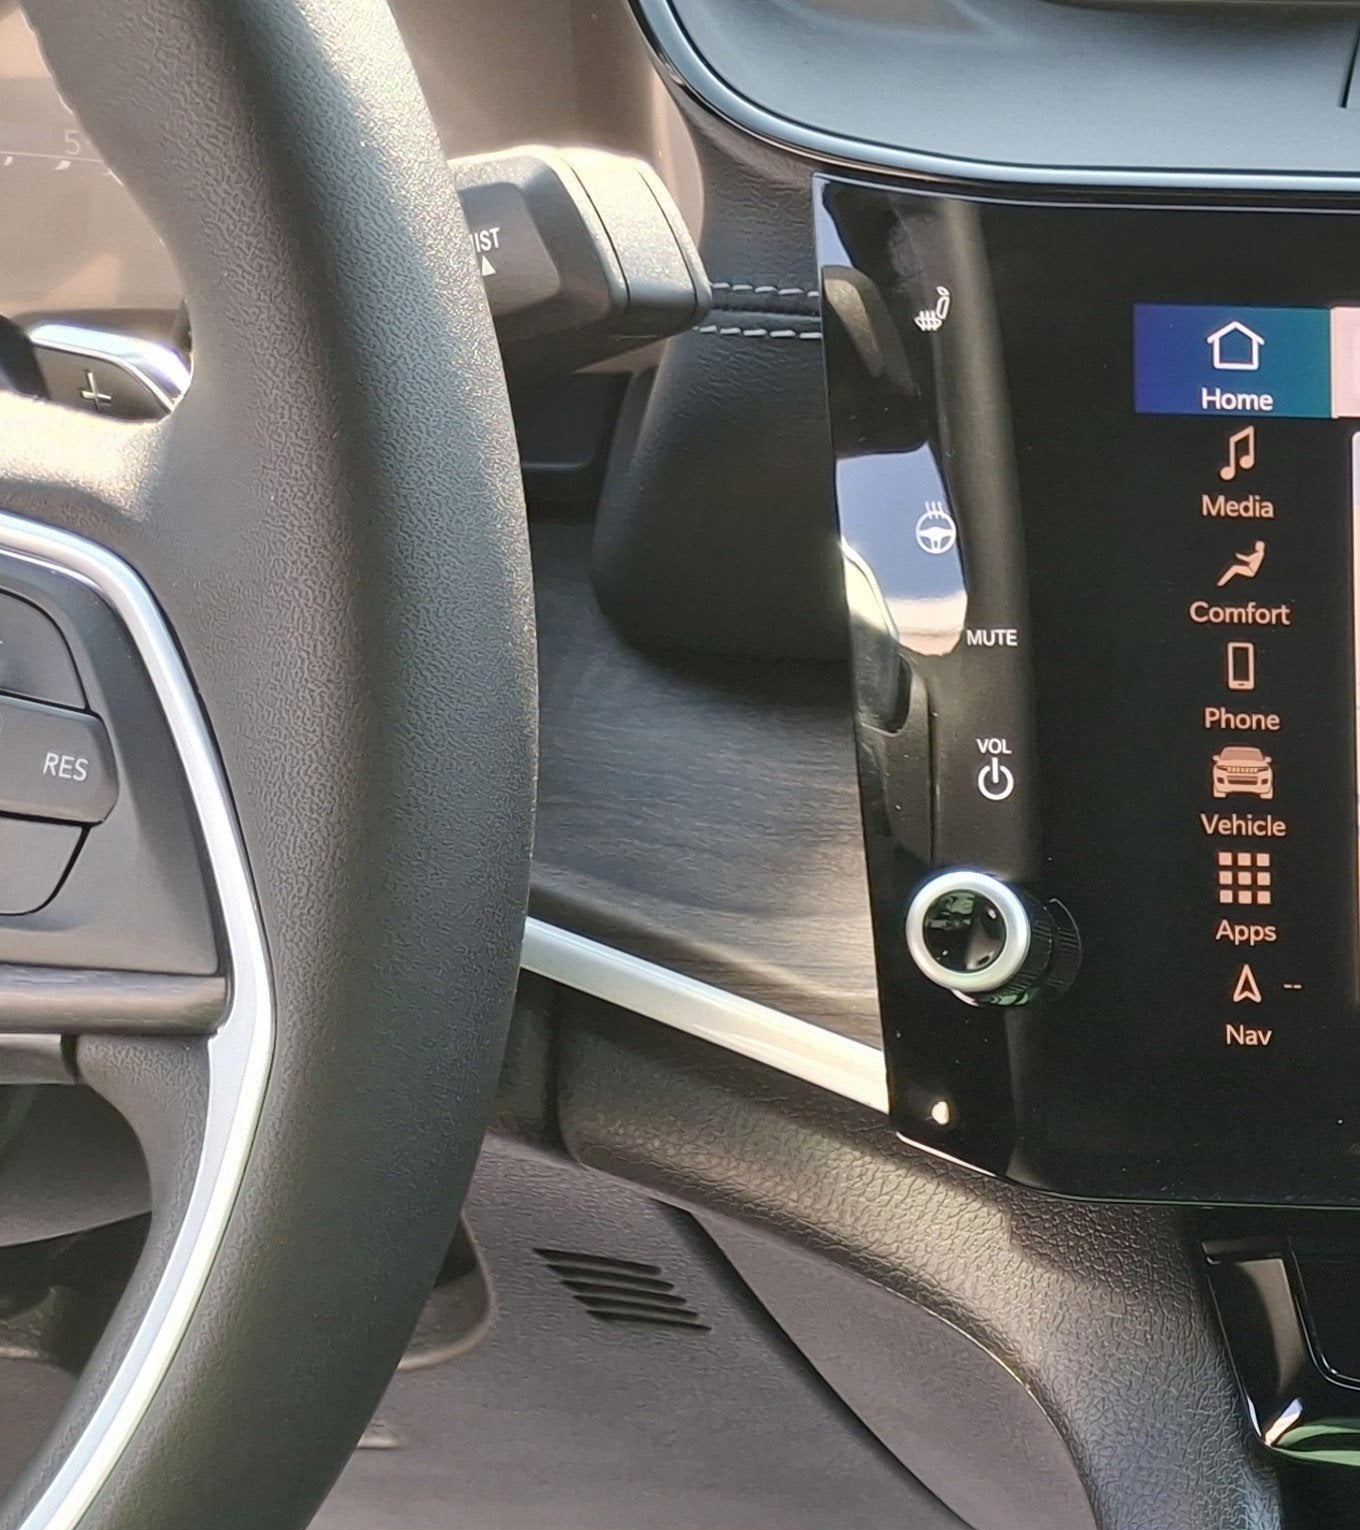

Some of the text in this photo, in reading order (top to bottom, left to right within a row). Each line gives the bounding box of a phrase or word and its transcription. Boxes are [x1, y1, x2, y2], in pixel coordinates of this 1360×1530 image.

[65, 130, 80, 155] 5
[468, 226, 500, 254] IST
[1202, 388, 1273, 410] Home
[1202, 495, 1273, 517] Media
[1190, 601, 1290, 625] Comfort
[967, 629, 1017, 646] MUTE
[1205, 707, 1280, 730] Phone
[976, 738, 1012, 754] VOL
[43, 752, 88, 781] RES
[1201, 814, 1286, 836] Vehicle
[1216, 920, 1276, 946] Apps
[1226, 1024, 1272, 1045] Nav
